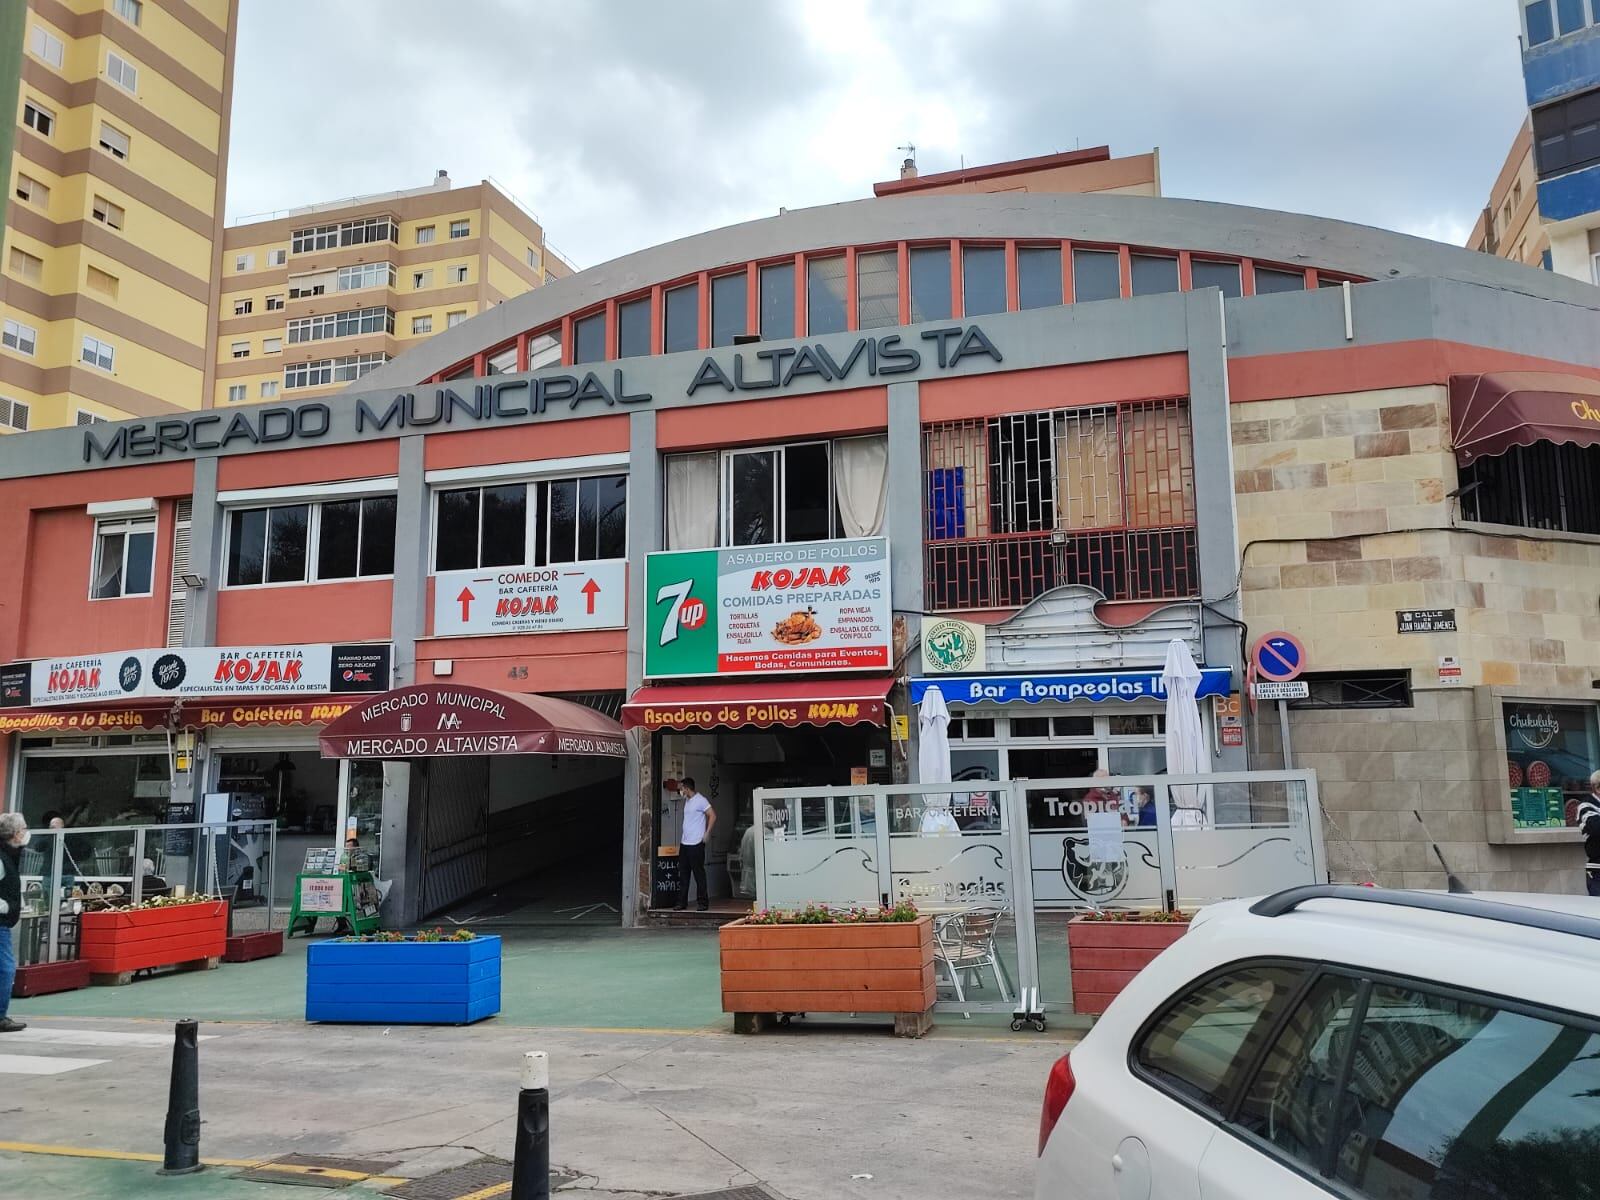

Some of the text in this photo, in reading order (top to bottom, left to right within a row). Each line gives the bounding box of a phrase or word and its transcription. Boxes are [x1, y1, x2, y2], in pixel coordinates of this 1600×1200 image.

[82, 323, 1003, 463] MERCADO MUNICIPAL ALTAVISTA
[727, 545, 877, 565] ASADERO DE POLLOS
[498, 570, 558, 584] COMEDOR
[751, 565, 851, 591] KOJAK
[517, 584, 558, 594] CAFETERÍA
[496, 595, 559, 617] KOJAK
[723, 589, 881, 608] COMIDAS PREPARADAS
[728, 621, 760, 630] CROQUETAS
[838, 616, 874, 624] EMPANADOS
[1400, 622, 1413, 631] JUAN
[726, 631, 763, 639] ENSALADILLA
[220, 650, 303, 660] BAR CAFETERÍA
[726, 649, 882, 662] Hacemos Comidas para Eventos,
[51, 663, 63, 671] BAR
[214, 659, 303, 683] KOJAK
[754, 659, 852, 669] Bodas, Comuniones.
[47, 668, 102, 694] KOJAK
[970, 683, 1006, 698] Bar
[1020, 677, 1143, 699] Rompeolas
[201, 709, 225, 723] Bar
[233, 706, 303, 721] Cafetería
[361, 693, 507, 723] MERCADO MUNICIPAL
[644, 703, 858, 724] Asadero de Pollos KOJAK
[68, 716, 78, 726] a
[81, 713, 95, 726] lo
[99, 711, 144, 726] Bestia
[347, 736, 518, 755] MERCADO ALTAVISTA
[558, 738, 627, 754] MERCADO ALTAVISTA
[895, 807, 921, 818] BAR
